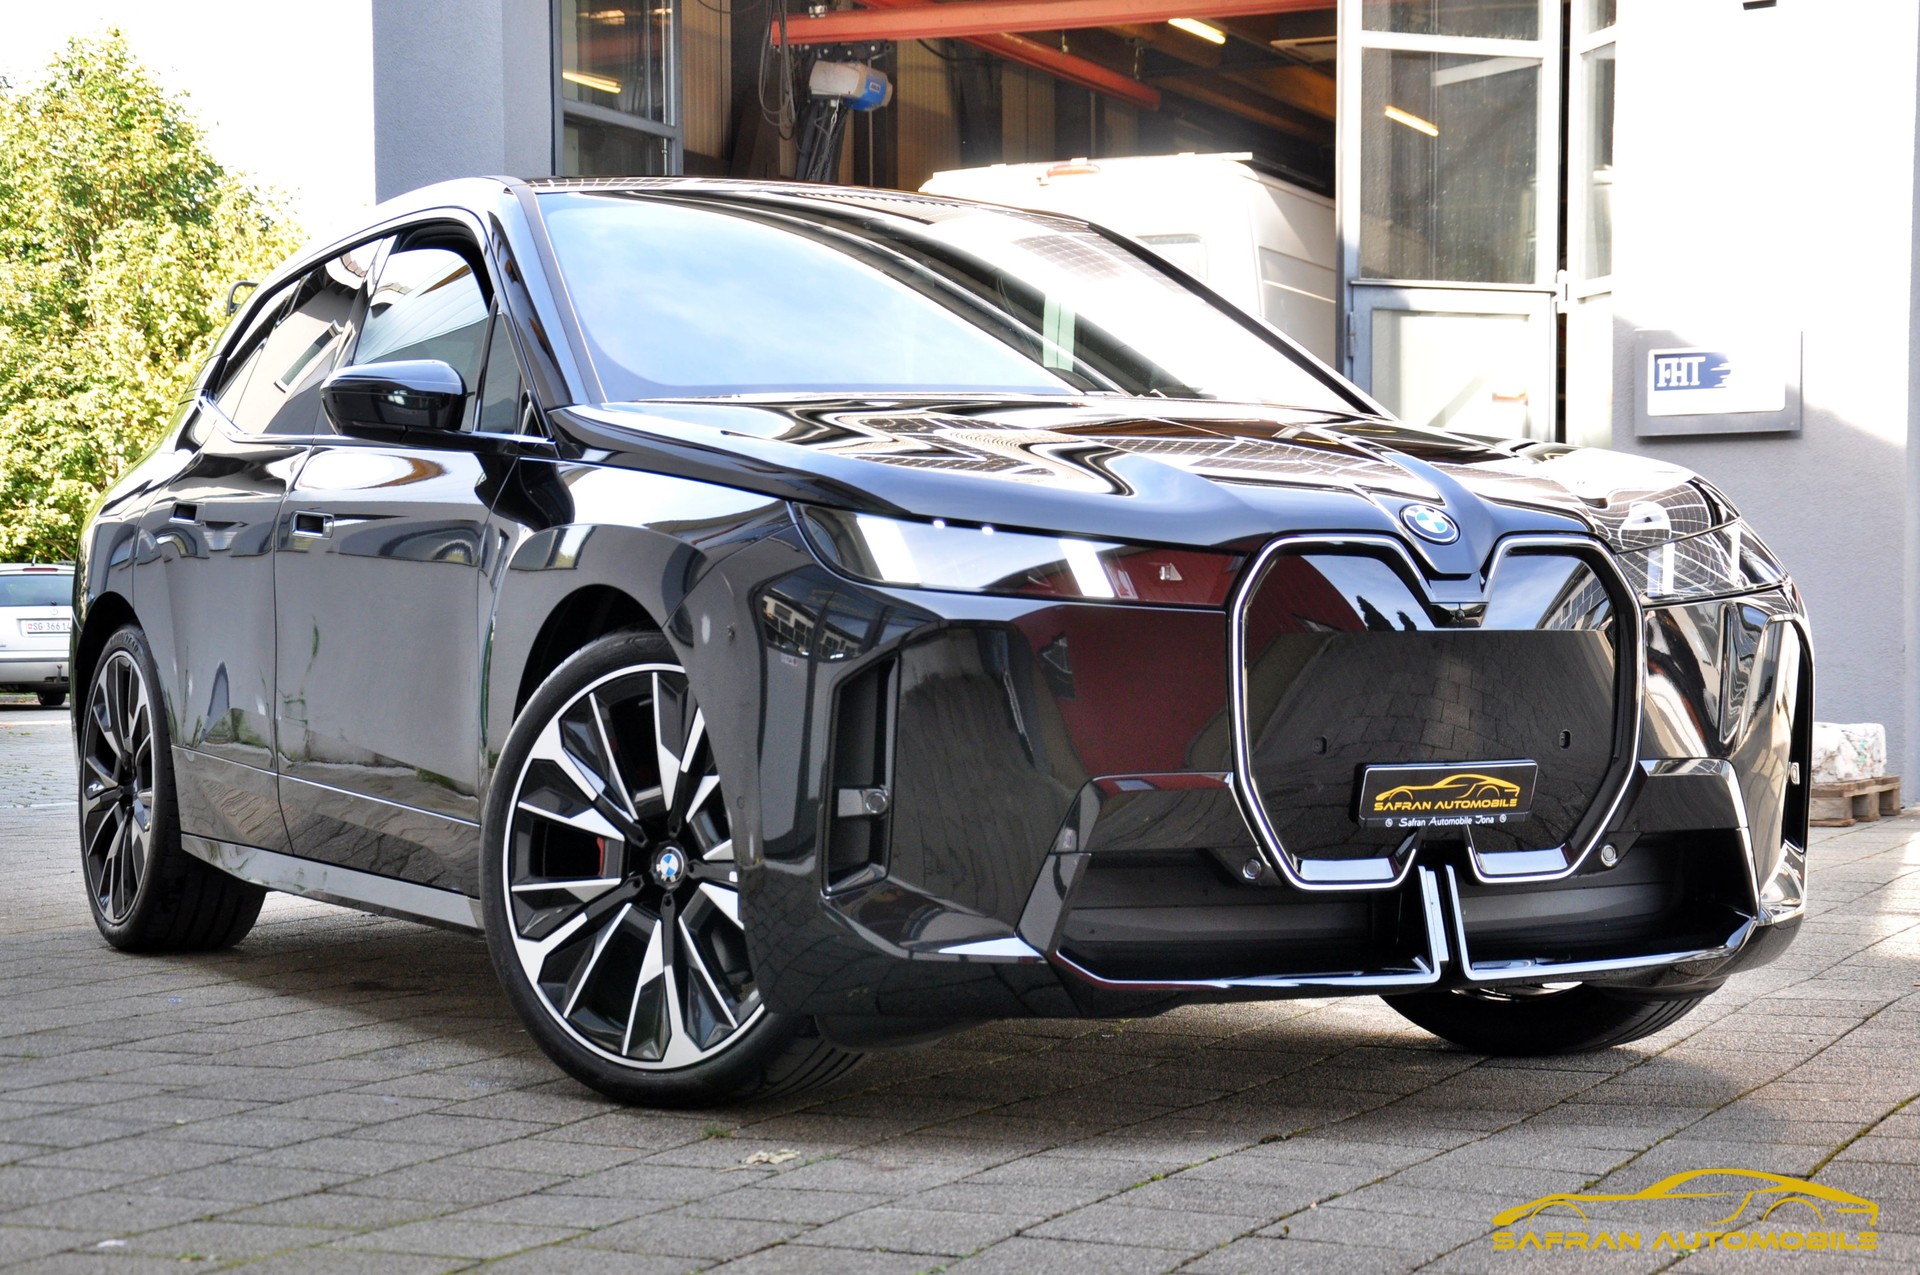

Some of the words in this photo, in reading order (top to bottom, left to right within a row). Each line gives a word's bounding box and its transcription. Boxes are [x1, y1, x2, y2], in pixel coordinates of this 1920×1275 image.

[1656, 356, 1706, 388] FHT
[33, 622, 43, 631] SG
[1374, 801, 1431, 811] SAFRAN
[1434, 799, 1517, 810] AUTOMOBILE
[1399, 817, 1426, 828] Safran
[1428, 816, 1472, 826] Automobile
[1475, 815, 1495, 825] Jona
